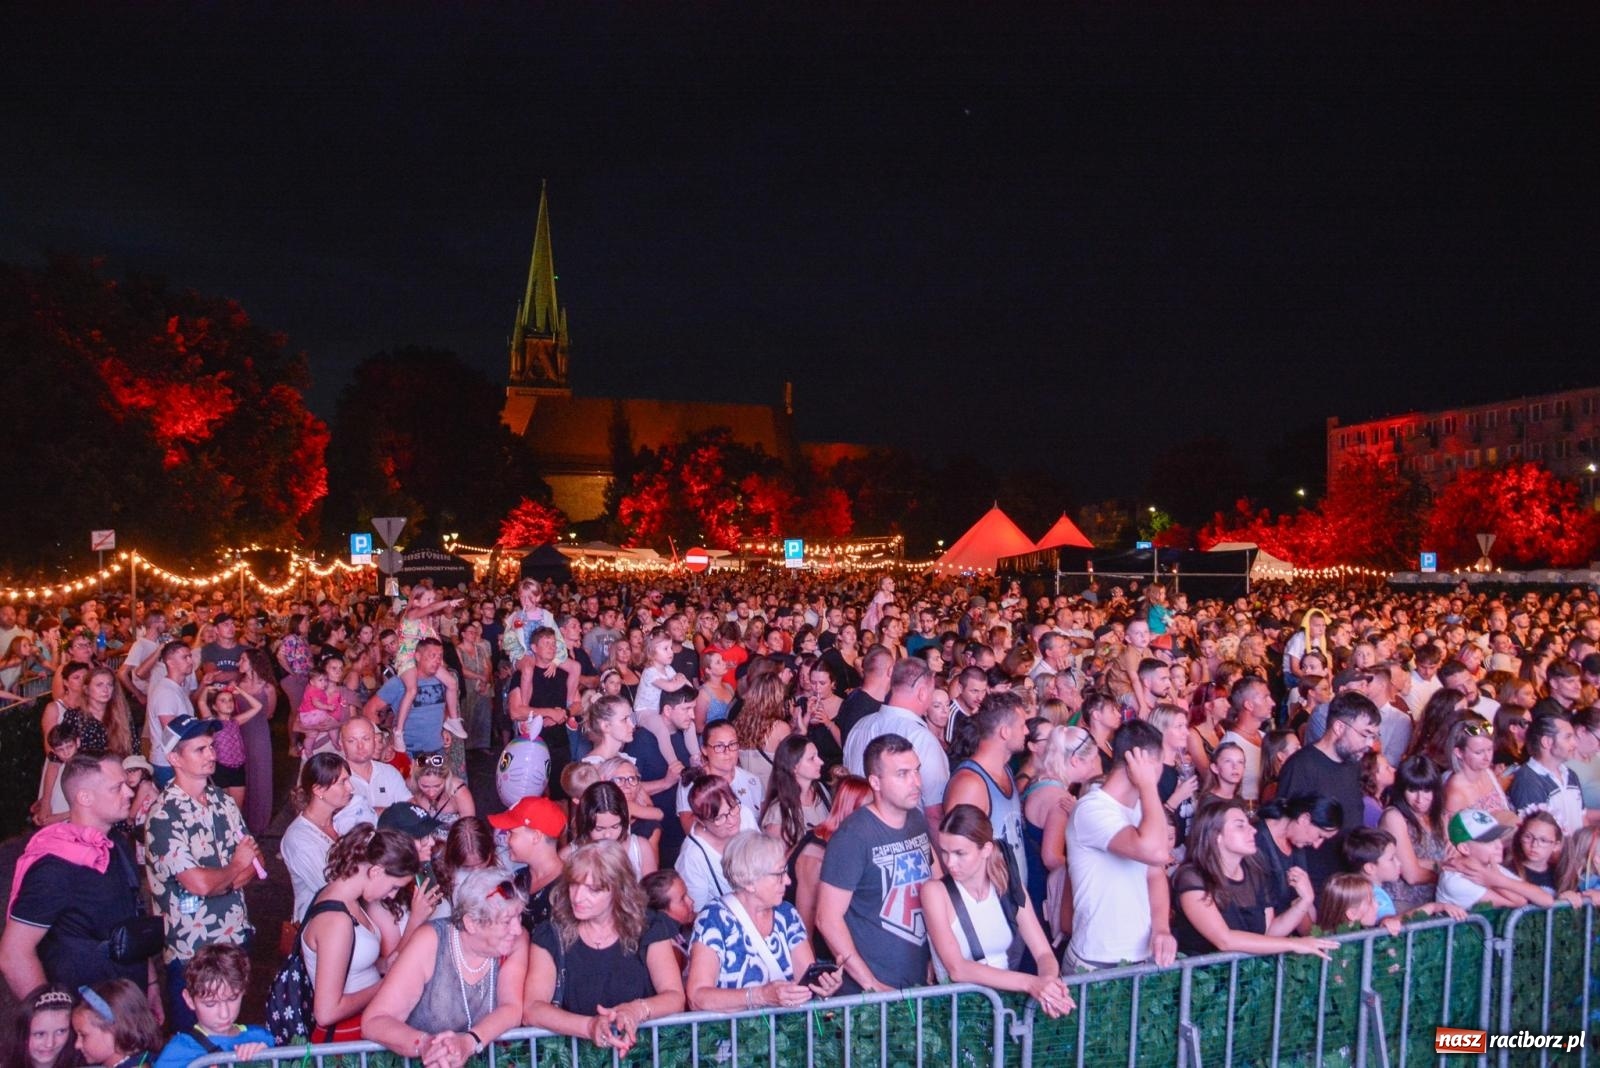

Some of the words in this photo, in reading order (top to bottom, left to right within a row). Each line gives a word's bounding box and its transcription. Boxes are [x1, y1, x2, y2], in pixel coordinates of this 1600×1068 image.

[355, 536, 367, 552] P
[788, 541, 800, 557] P
[1423, 554, 1433, 566] P
[871, 840, 906, 857] CAPTAIN
[903, 832, 929, 850] AMERIC
